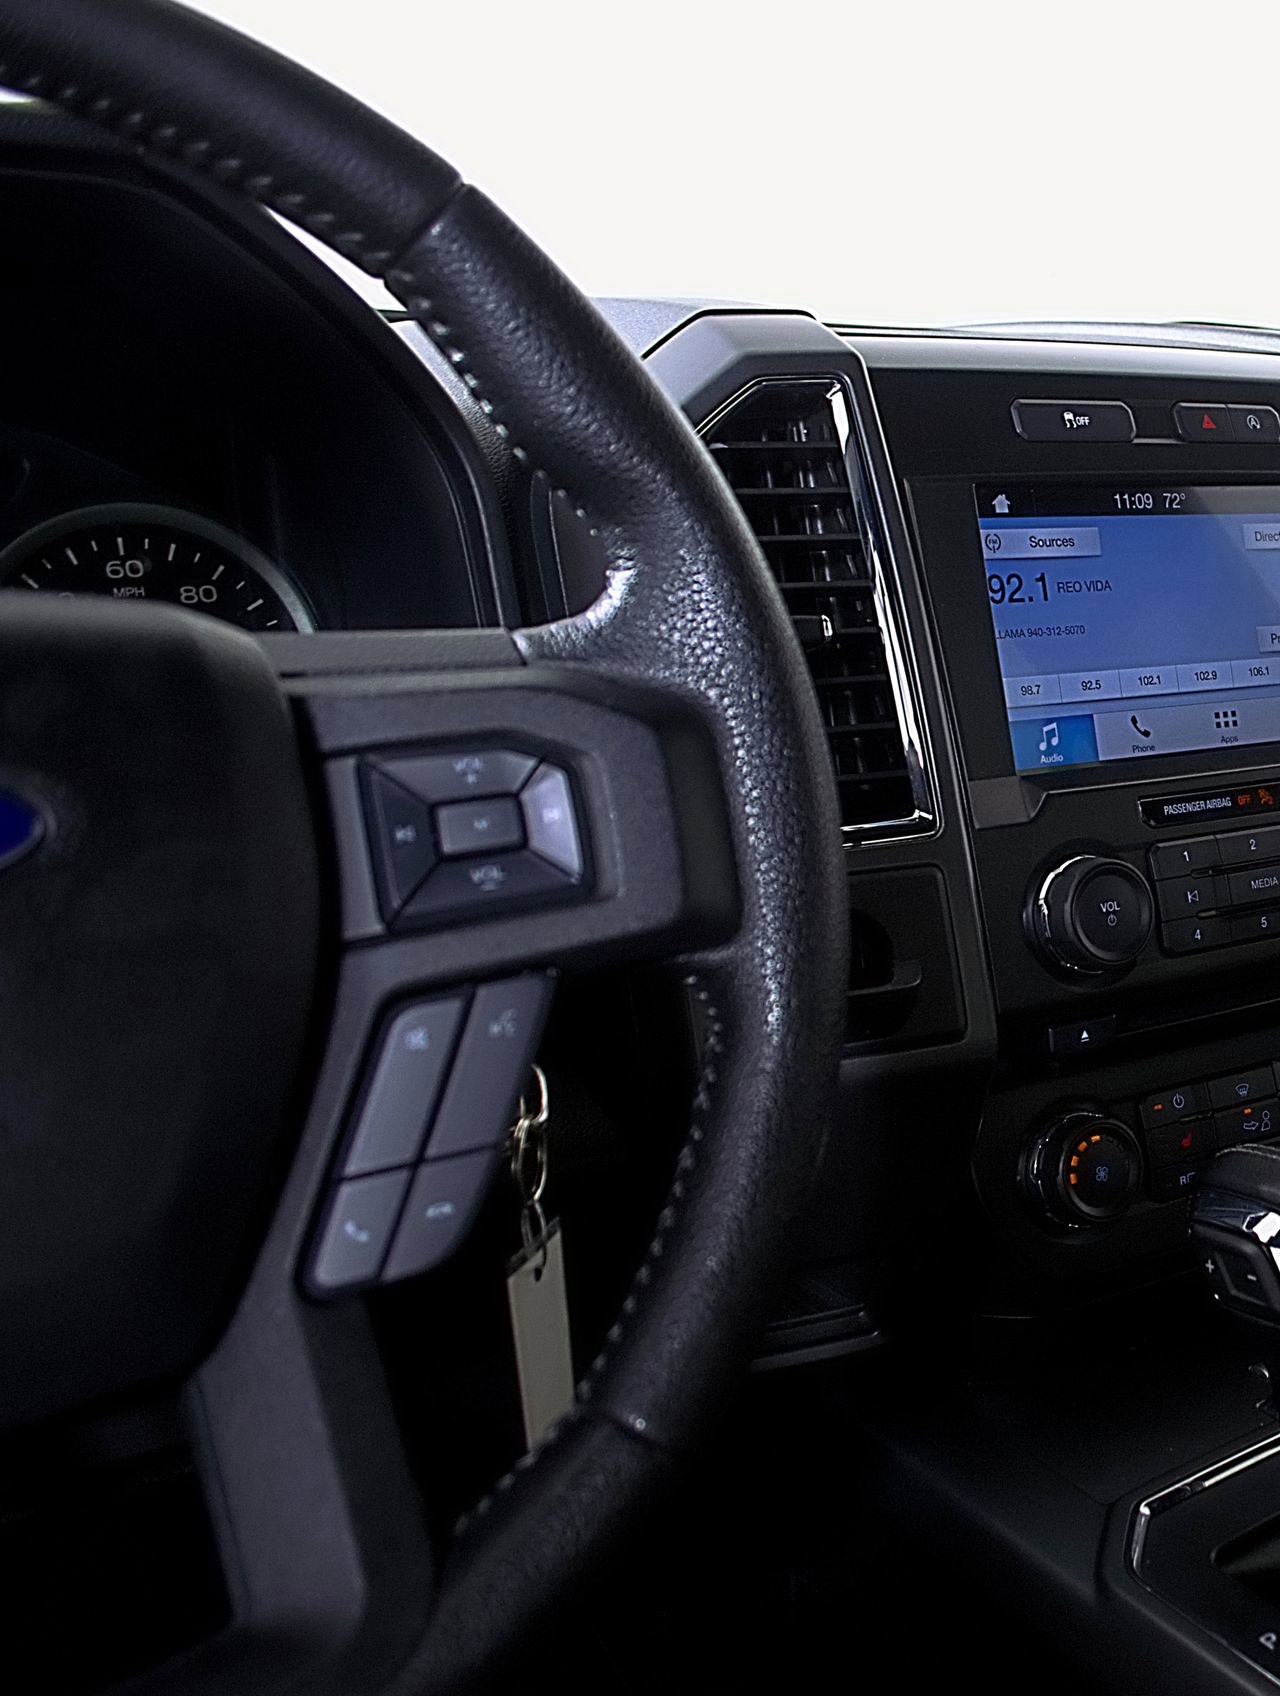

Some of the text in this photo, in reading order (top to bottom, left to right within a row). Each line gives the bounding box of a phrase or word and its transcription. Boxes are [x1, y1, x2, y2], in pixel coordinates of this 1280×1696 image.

[1075, 416, 1090, 426] OFF
[1114, 492, 1186, 509] 11:09 72°
[1029, 535, 1075, 549] Sources
[105, 559, 145, 579] 60
[112, 586, 146, 599] MPH
[179, 585, 218, 604] 80
[987, 572, 1113, 605] 92.1 REO VIDA
[1027, 624, 1085, 638] 940-312-5070
[1020, 684, 1041, 697] 98.7
[1081, 679, 1102, 692] 92.5
[1137, 674, 1162, 687] 102.1
[1194, 669, 1218, 682] 102.9
[1248, 665, 1270, 678] 106.1
[1040, 753, 1064, 764] Audio
[1132, 743, 1156, 754] Phone
[1220, 734, 1239, 746] Apps
[1163, 794, 1252, 816] PASSENGER AIRBAG OFF
[1248, 838, 1257, 851] 2
[1182, 850, 1190, 862] 1
[1250, 875, 1280, 890] MEDIA
[1100, 900, 1121, 913] VOL
[1260, 916, 1269, 928] 5
[1194, 928, 1202, 941] 4
[1259, 1631, 1277, 1651] P
